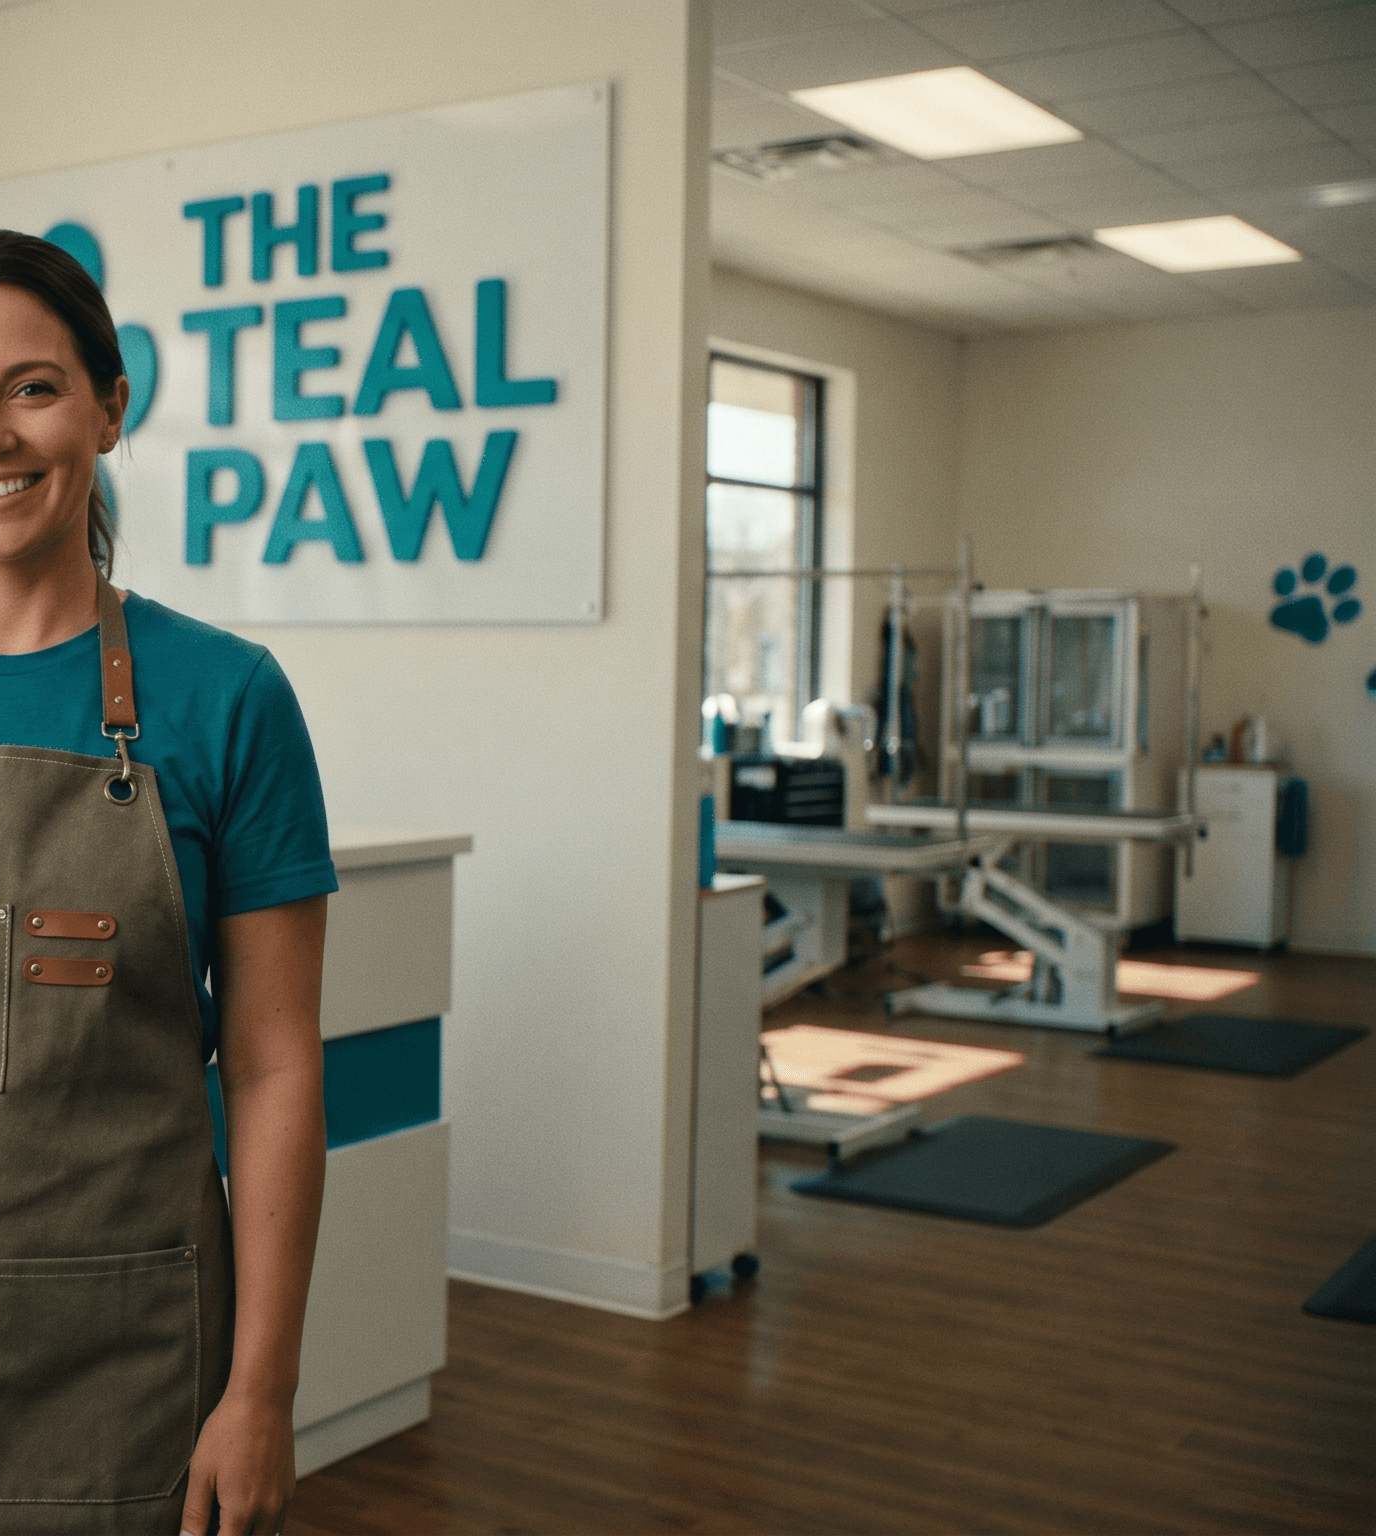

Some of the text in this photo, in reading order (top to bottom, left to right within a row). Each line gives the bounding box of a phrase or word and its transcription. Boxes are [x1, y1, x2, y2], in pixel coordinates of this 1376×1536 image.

[181, 172, 392, 289] THE
[180, 277, 560, 428] TEAL
[183, 428, 521, 567] PAW
